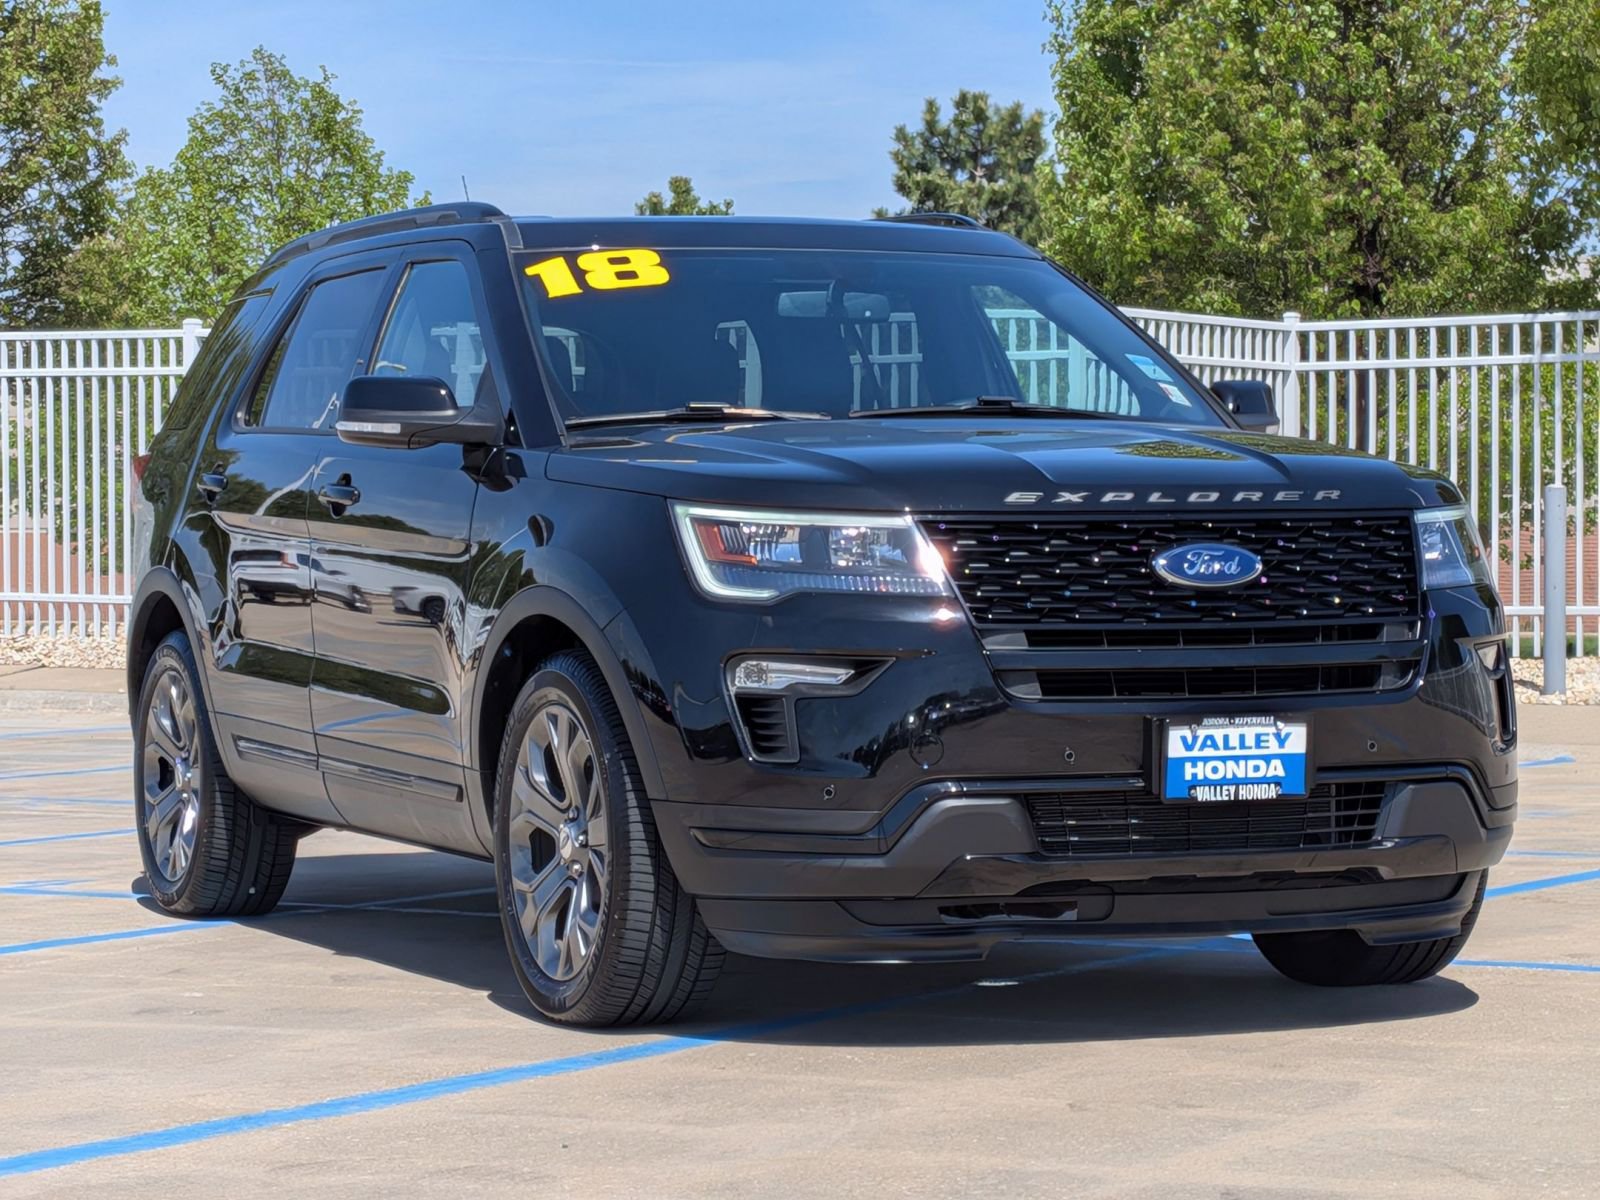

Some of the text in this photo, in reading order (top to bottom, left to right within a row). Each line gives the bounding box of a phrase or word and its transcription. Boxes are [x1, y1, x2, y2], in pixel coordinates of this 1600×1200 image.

[524, 249, 670, 298] 18
[1004, 490, 1341, 503] EXPLORER
[1183, 549, 1241, 576] Ford
[1179, 732, 1293, 752] VALLEY
[1184, 759, 1286, 781] HONDA
[1196, 784, 1276, 802] VALLEY HONDA
